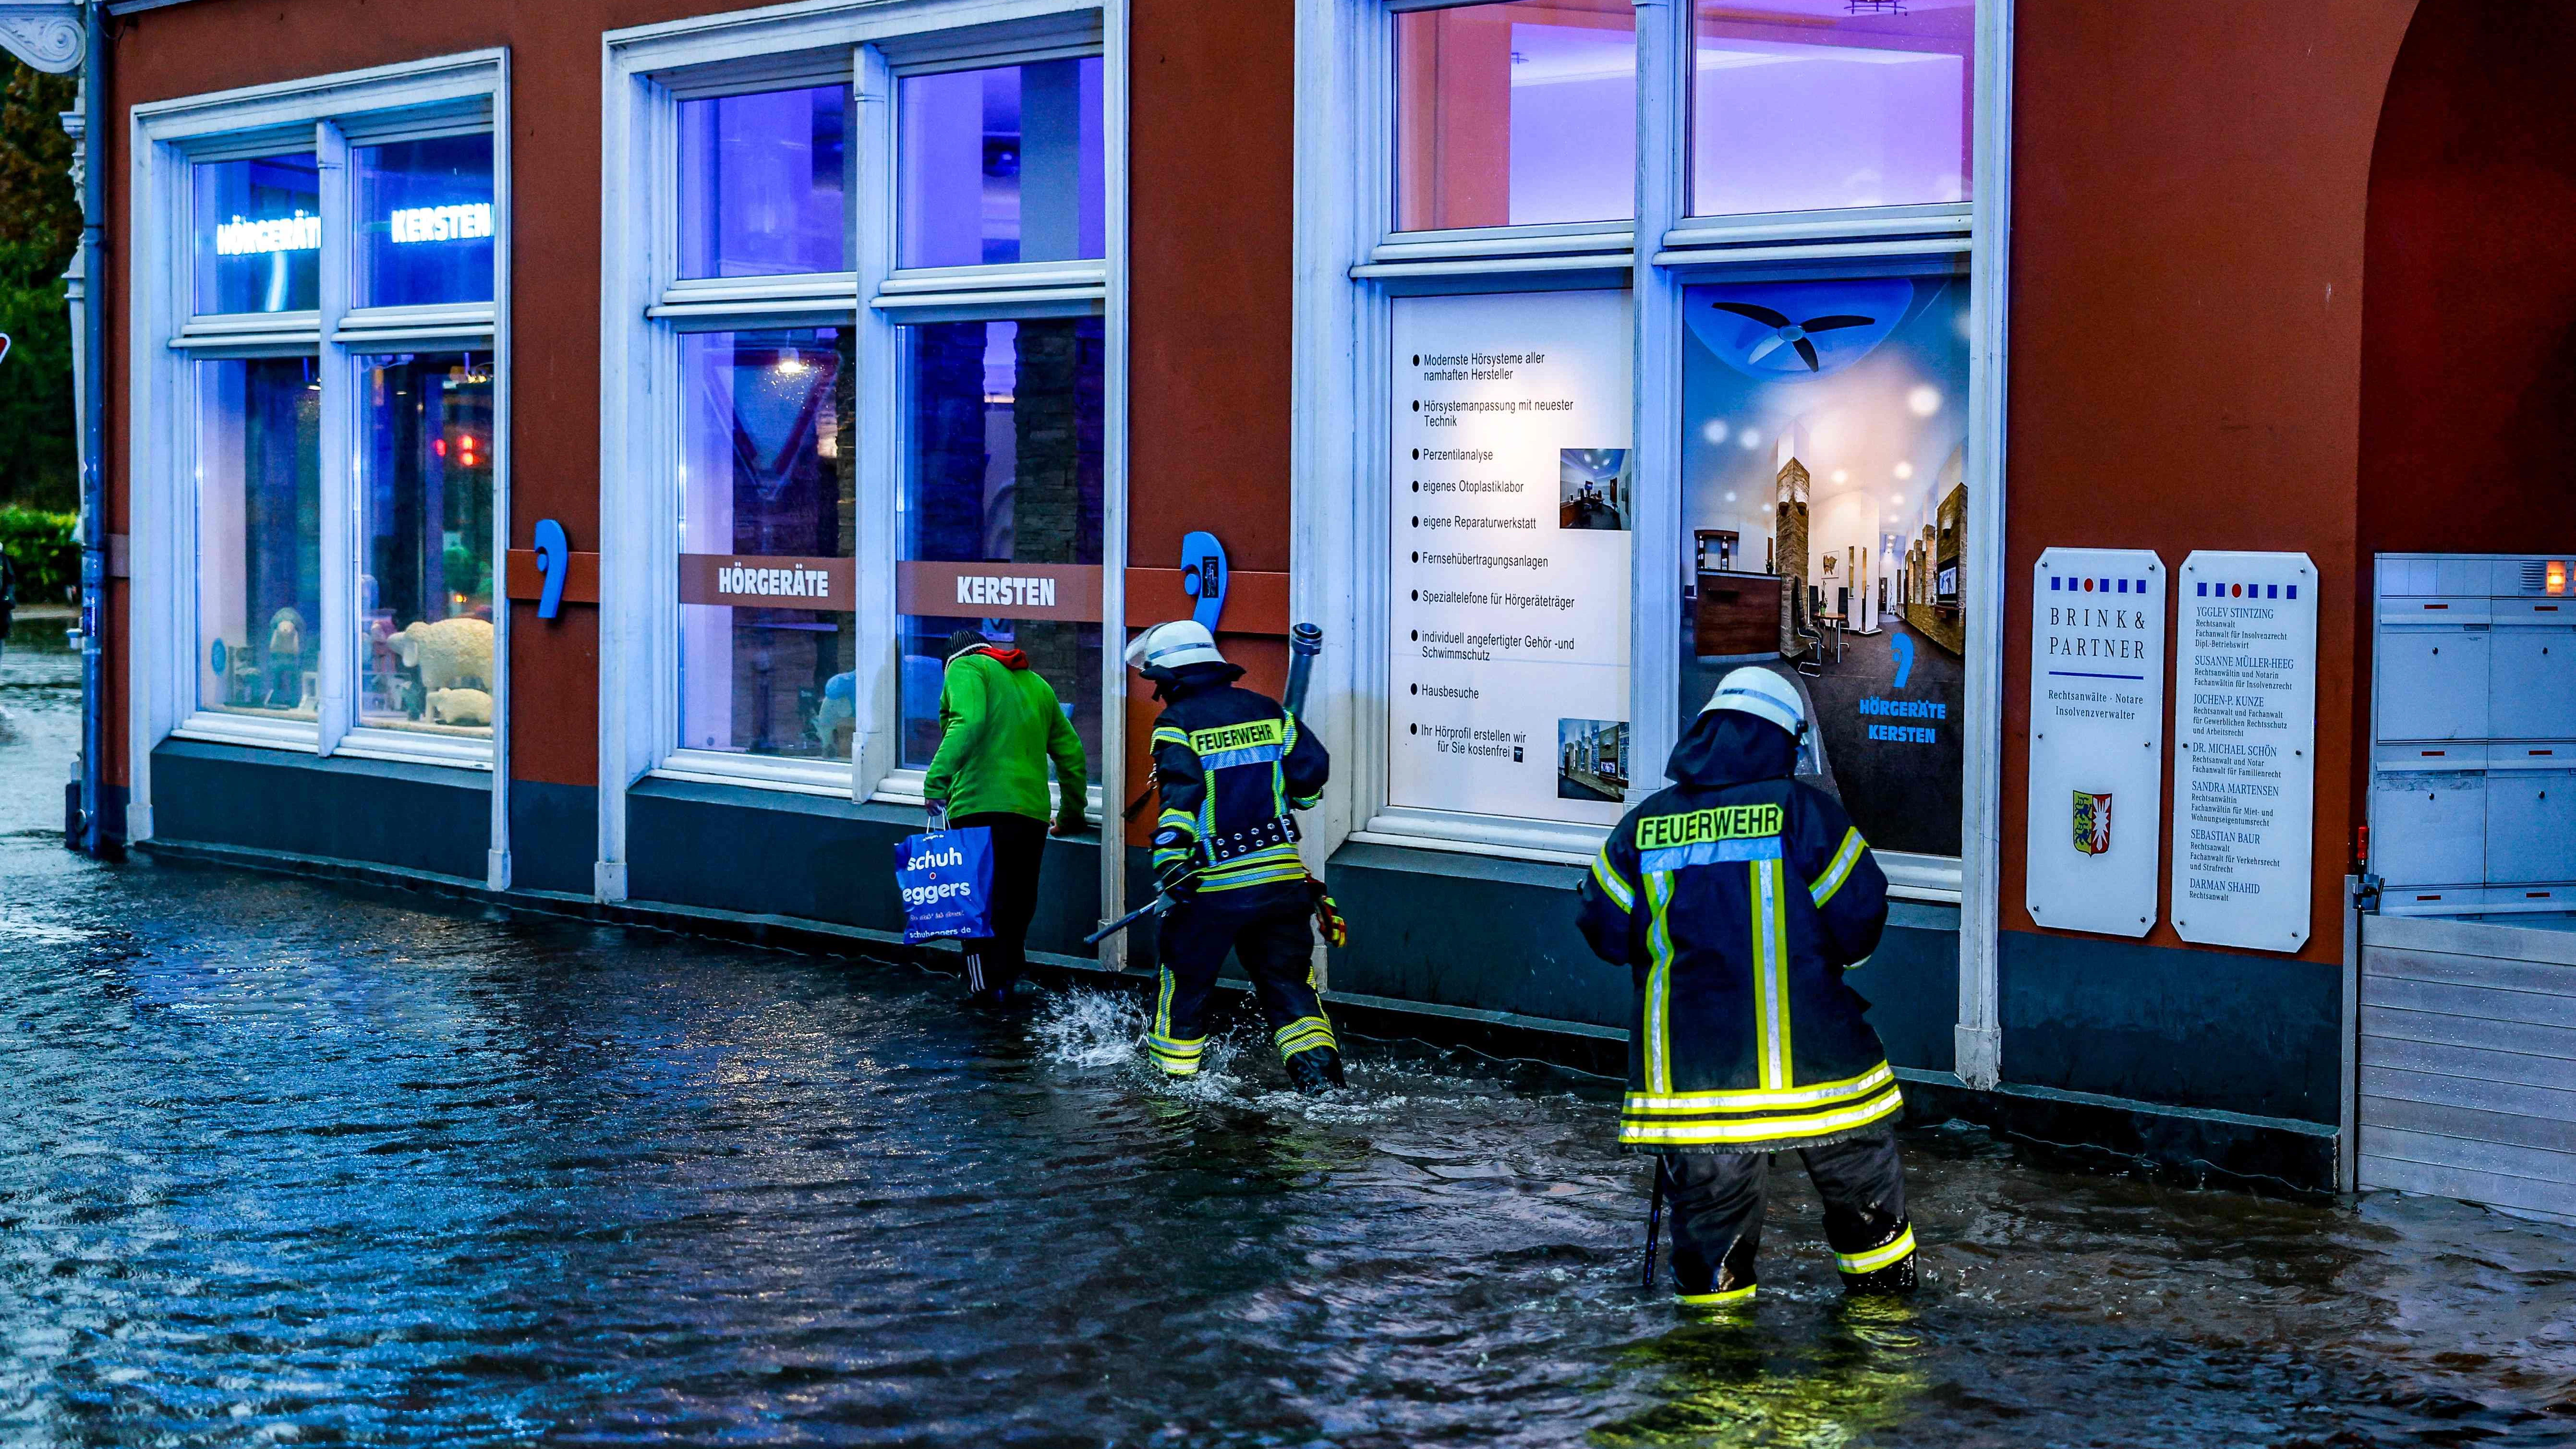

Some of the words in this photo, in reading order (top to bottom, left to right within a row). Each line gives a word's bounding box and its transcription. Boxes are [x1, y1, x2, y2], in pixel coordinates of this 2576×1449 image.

[391, 203, 491, 243] KERSTEN
[1424, 353, 1468, 366] Modernste
[1471, 353, 1523, 366] Hörsysteme
[1525, 352, 1545, 364] aller
[1424, 368, 1468, 381] namhaften
[1471, 368, 1513, 380] Hersteller
[1424, 400, 1515, 414] Hörsystemanpassung
[1519, 399, 1532, 411] mit
[1535, 399, 1573, 411] neuester
[1424, 414, 1457, 427] Technik
[1423, 448, 1493, 463] Perzentilanalyse
[1423, 480, 1456, 494] eigenes
[1459, 480, 1524, 494] Otoplastiklabor
[1423, 516, 1451, 530] eigene
[1454, 516, 1536, 530] Reparaturwerkstatt
[1423, 552, 1548, 569] Fernsehübertragungsanlagen
[719, 562, 829, 597] HÖRGERÄTE
[957, 576, 1055, 607] KERSTEN
[1423, 590, 1488, 605] Spezialtelefone
[1490, 592, 1502, 605] für
[1505, 593, 1574, 610] Hörgeräteträger
[2050, 607, 2127, 628] BRINK
[2135, 611, 2145, 629] &
[2197, 606, 2228, 617] YGGLEV
[2230, 608, 2274, 619] STINTZING
[2196, 619, 2235, 628] Rechtsanwalt
[1422, 631, 1464, 644] individuell
[1467, 632, 1522, 649] angefertigter
[1524, 635, 1552, 648] Gehör
[1554, 638, 1574, 650] -und
[2196, 629, 2229, 638] Fachanwalt
[2242, 631, 2287, 640] Insolvenzrecht
[2049, 637, 2144, 659] PARTNER
[2195, 640, 2249, 649] Dipl.-Betriebswirt
[1422, 646, 1490, 661] Schwimmschutz
[2195, 655, 2233, 667] SUSANNE
[2236, 655, 2294, 669] MÜLLER-HEEG
[2195, 668, 2240, 677] Rechtsanwältin
[2242, 669, 2254, 677] und
[2255, 670, 2279, 679] Notarin
[1421, 684, 1479, 699] Hausbesuche
[2194, 678, 2233, 687] Fachanwältin
[2247, 680, 2292, 690] Insolvenzrecht
[2048, 689, 2107, 702] Rechtsanwälte
[2116, 693, 2143, 704] Notare
[2193, 694, 2233, 705] JOCHEN-P.
[2236, 696, 2264, 707] KUNZE
[1860, 695, 1946, 719] HÖRGERÄTE
[2056, 706, 2135, 720] Insolvenzverwalter
[2193, 707, 2233, 716] Rechtsanwalt
[2235, 708, 2246, 716] und
[2249, 710, 2283, 718] Fachanwalt
[2204, 717, 2245, 726] Gewerblichen
[2247, 720, 2287, 729] Rechtsschutz
[1196, 724, 1274, 751] FEUERWEHR
[1421, 724, 1432, 737] Ihr
[1435, 725, 1471, 741] Hörprofil
[1474, 727, 1511, 742] erstellen
[1513, 731, 1526, 743] wir
[1869, 725, 1935, 743] KERSTEN
[2206, 728, 2244, 737] Arbeitsrecht
[1438, 741, 1449, 753] für
[1451, 742, 1465, 754] Sie
[1468, 742, 1510, 758] kostenfrei
[2193, 742, 2206, 752] DR.
[2208, 743, 2246, 755] MICHAEL
[2248, 745, 2277, 757] SCHÖN
[2192, 755, 2232, 765] Rechtsanwalt
[2234, 757, 2245, 765] und
[2247, 759, 2264, 767] Notar
[2192, 765, 2225, 774] Fachanwalt
[2238, 768, 2281, 778] Familienrecht
[2192, 781, 2225, 793] SANDRA
[2227, 783, 2279, 797] MARTENSEN
[2191, 793, 2237, 804] Rechtsanwältin
[2191, 803, 2231, 813] Fachanwältin
[2233, 806, 2242, 814] für
[2244, 807, 2260, 816] Miet-
[1641, 807, 1777, 845] FEUERWEHR
[2191, 813, 2269, 827] Wohnungseigentumsrecht
[2190, 829, 2236, 842] SEBASTIAN
[2237, 833, 2260, 845] BAUR
[2190, 842, 2230, 852] Rechtsanwalt
[907, 847, 963, 871] schuh
[2190, 852, 2224, 862] Fachanwalt
[2237, 856, 2280, 867] Verkehrsrecht
[2203, 863, 2233, 873] Strafrecht
[903, 882, 971, 905] eggers
[2189, 878, 2226, 891] DARMAN
[2228, 881, 2260, 894] SHAHID
[2189, 891, 2229, 901] Rechtsanwalt
